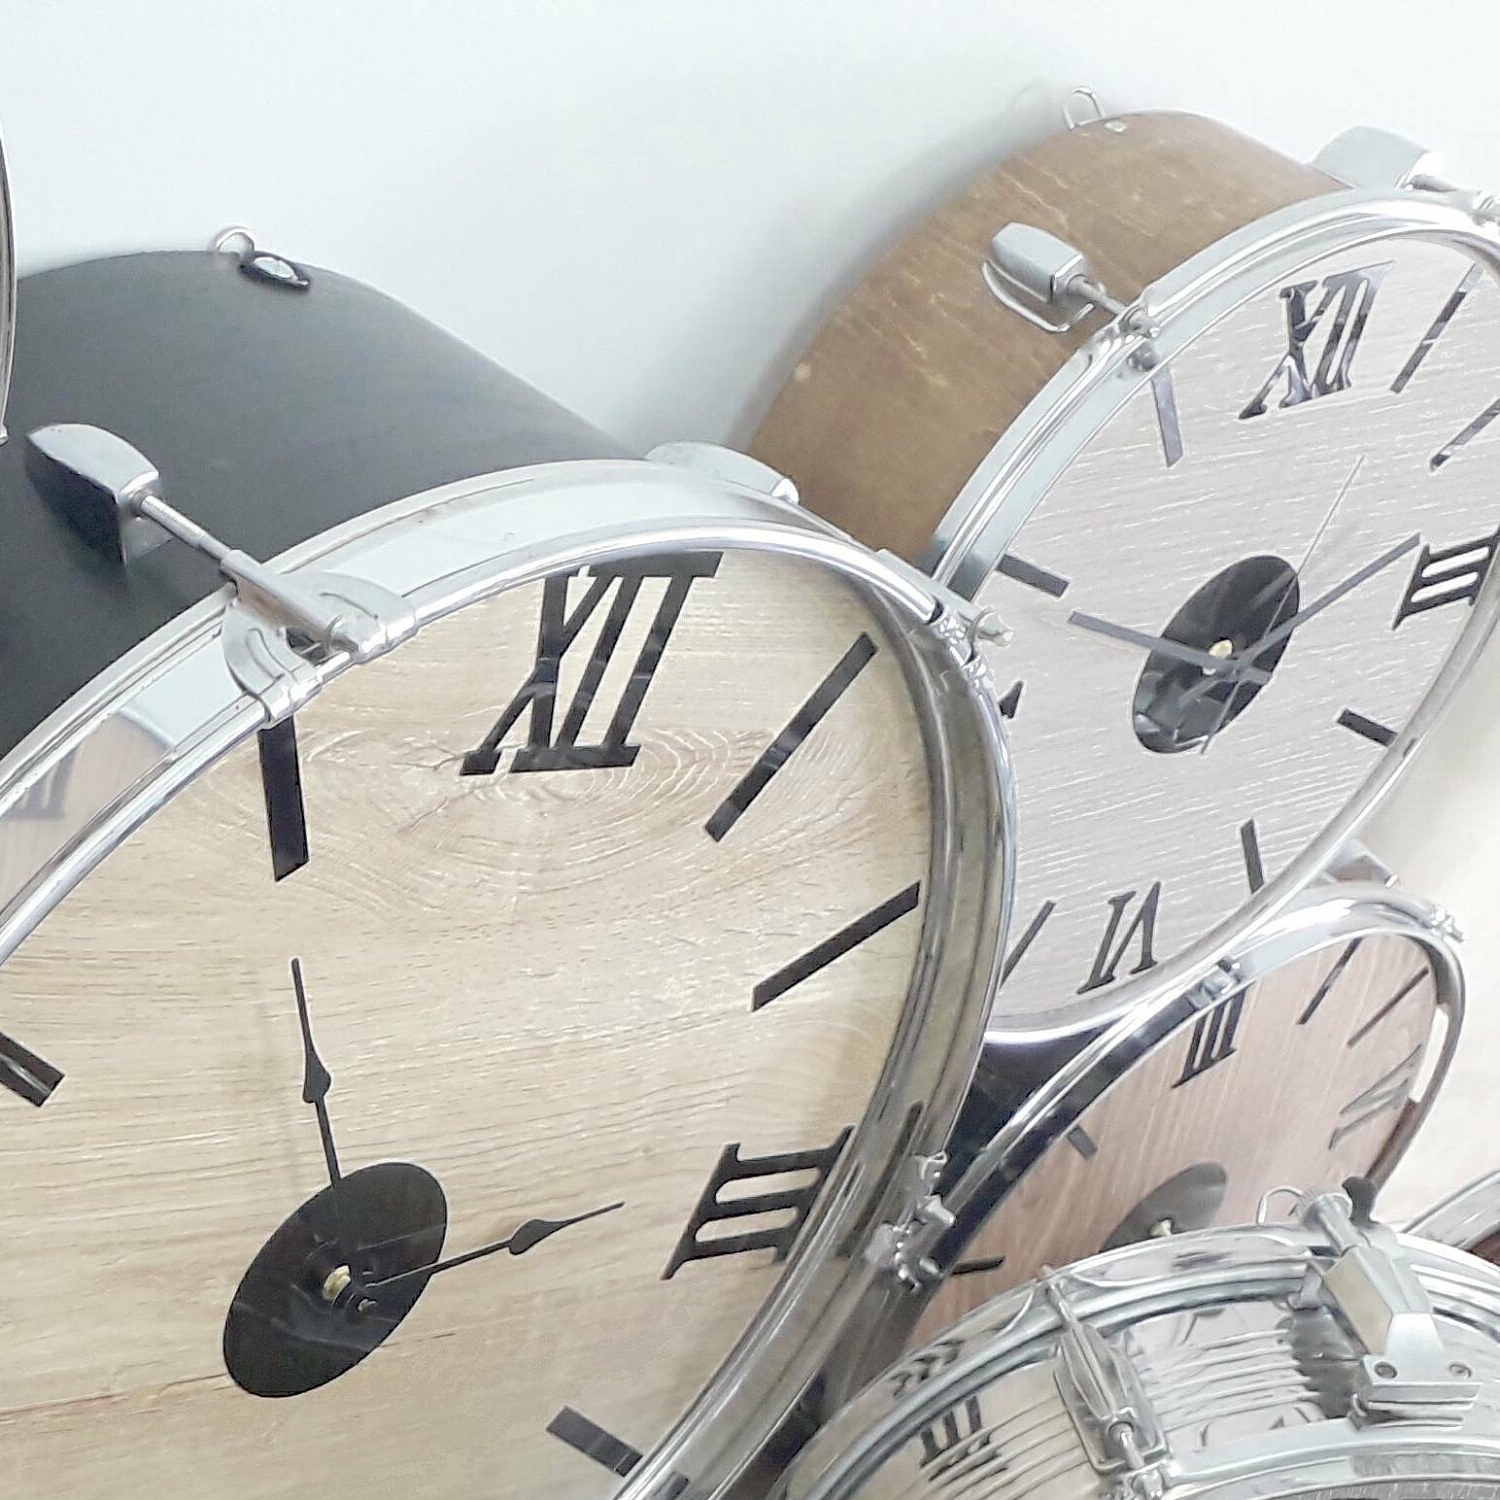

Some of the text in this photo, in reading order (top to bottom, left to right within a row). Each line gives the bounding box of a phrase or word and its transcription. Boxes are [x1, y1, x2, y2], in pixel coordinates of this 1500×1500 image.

[1238, 260, 1396, 421] XII
[1391, 524, 1500, 631] III
[459, 551, 724, 776] XII
[1077, 881, 1162, 995] VI
[1170, 981, 1257, 1089] III
[661, 1125, 856, 1280] III
